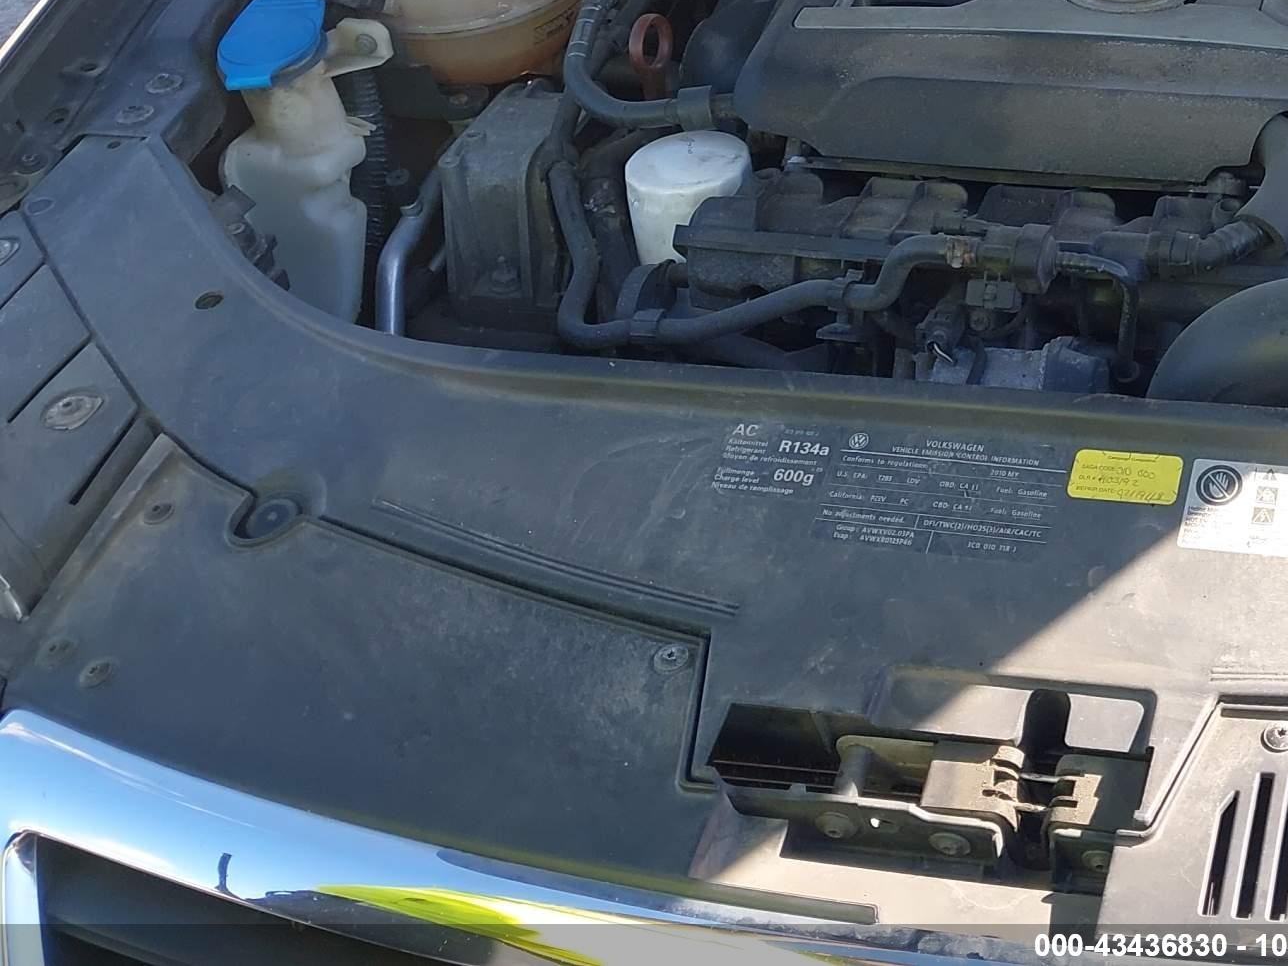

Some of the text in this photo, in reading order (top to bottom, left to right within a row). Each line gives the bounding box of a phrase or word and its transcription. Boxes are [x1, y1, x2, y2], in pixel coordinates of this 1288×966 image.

[732, 424, 759, 436] AC
[779, 440, 830, 455] R134a
[926, 440, 985, 452] VOLKSWAGEN
[842, 455, 874, 464] Conforms
[892, 446, 919, 454] VEHICLE
[921, 449, 954, 457] EMISSION
[990, 456, 1040, 466] INFORMATION
[714, 473, 739, 483] Charge
[774, 469, 815, 486] 600g
[712, 481, 736, 489] Niveau
[750, 485, 794, 495] remplissage
[1017, 488, 1048, 497] Gasoline
[1011, 509, 1041, 518] Gasoline
